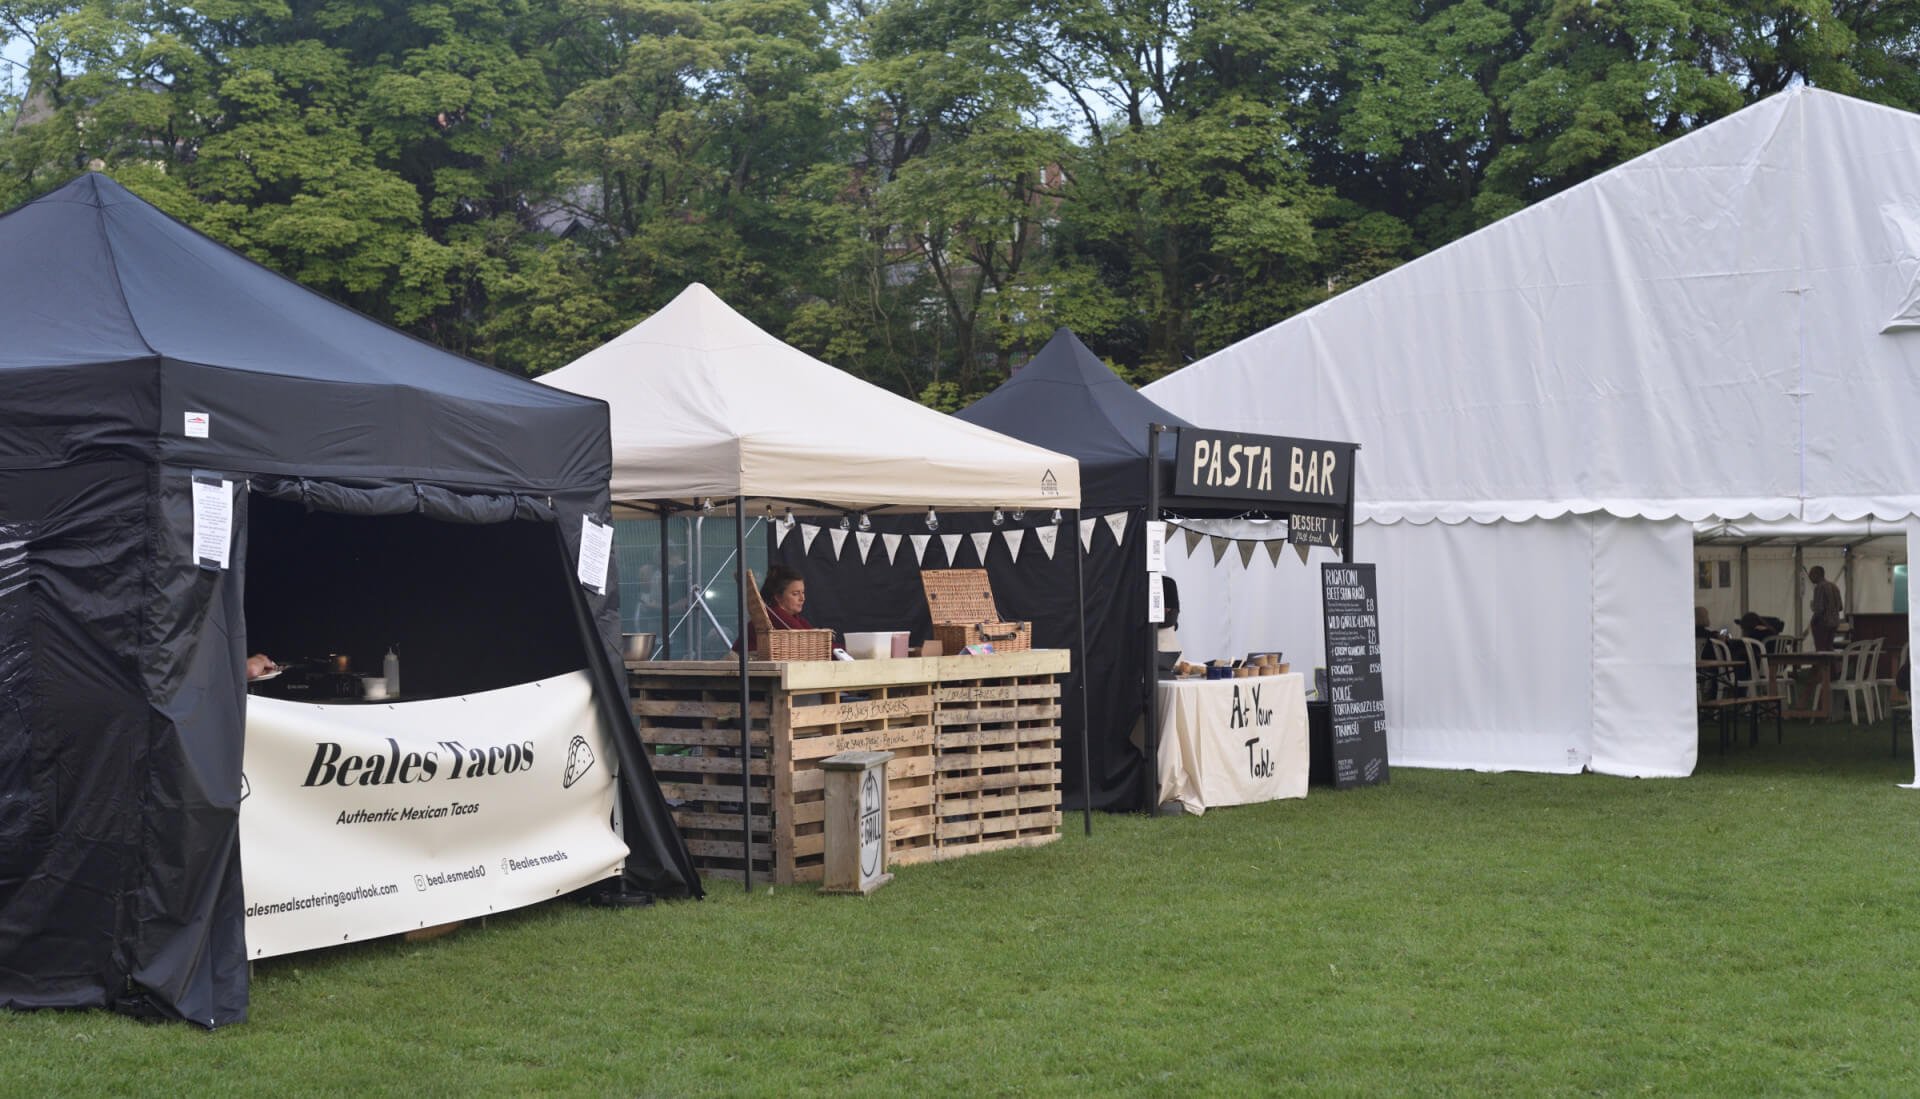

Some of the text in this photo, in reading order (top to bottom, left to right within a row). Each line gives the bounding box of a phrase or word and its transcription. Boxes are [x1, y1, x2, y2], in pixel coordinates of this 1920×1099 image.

[1193, 440, 1336, 496] PASTA BAR
[1291, 514, 1328, 533] DESSERT
[1326, 568, 1357, 586] RIGATONI
[1327, 586, 1340, 600] BEEF
[1230, 683, 1273, 729] At Your
[1332, 685, 1352, 702] DOLCE
[300, 738, 535, 788] Beales Tacos
[1245, 737, 1275, 779] Table
[336, 801, 480, 825] Authentic Mexican Tacos
[864, 813, 881, 846] GRILL
[509, 850, 568, 871] Beales meals
[245, 883, 399, 917] alesmealscatering@outlook.com
